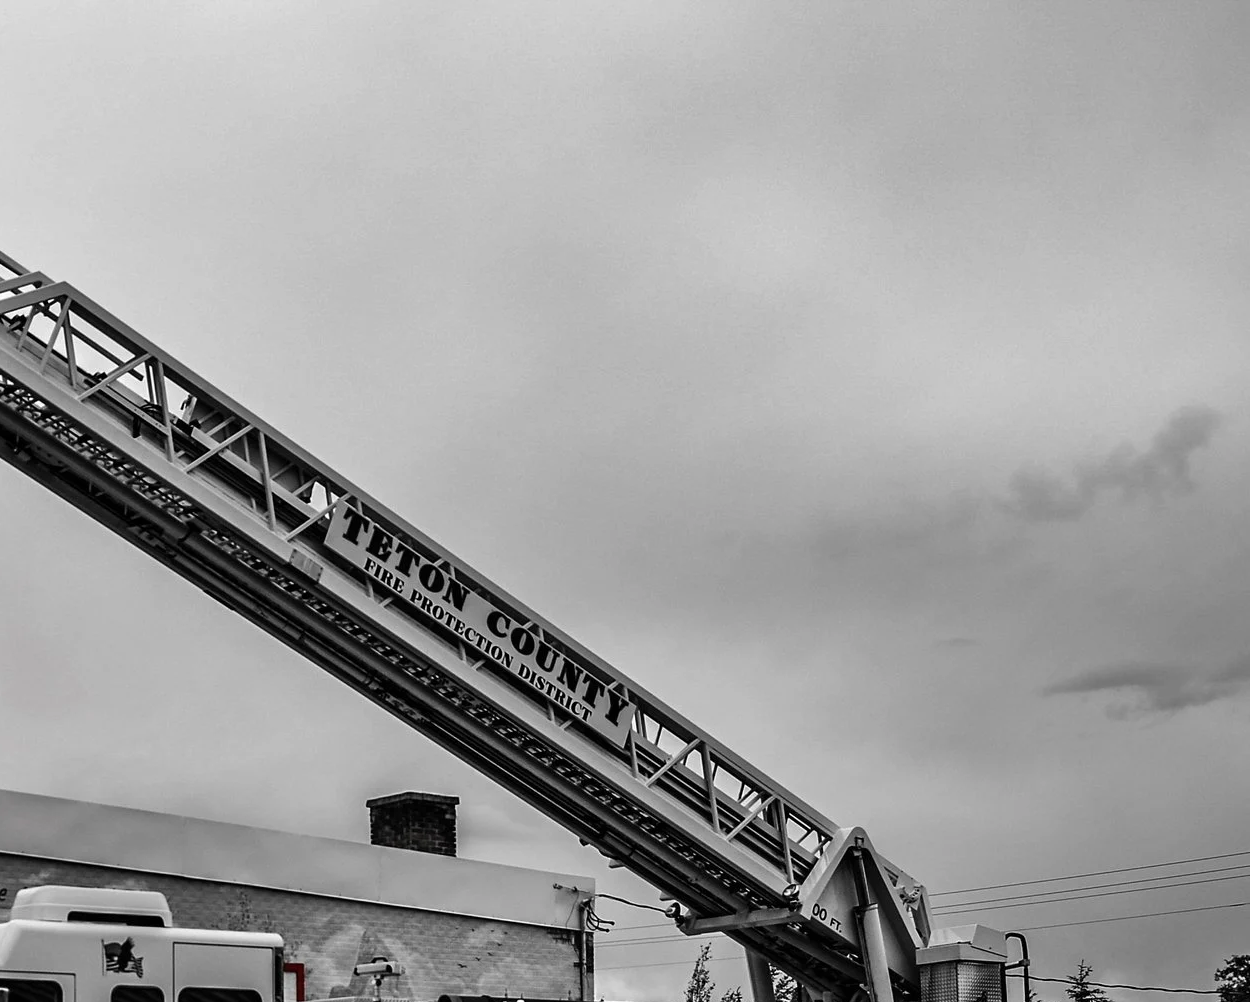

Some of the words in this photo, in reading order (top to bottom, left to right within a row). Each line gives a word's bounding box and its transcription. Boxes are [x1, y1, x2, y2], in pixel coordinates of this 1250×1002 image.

[342, 508, 471, 612] TETON
[486, 610, 630, 727] COUNTY
[363, 557, 405, 593] FIRE
[409, 590, 514, 669] PROTECTION
[518, 662, 593, 720] DISTRICT
